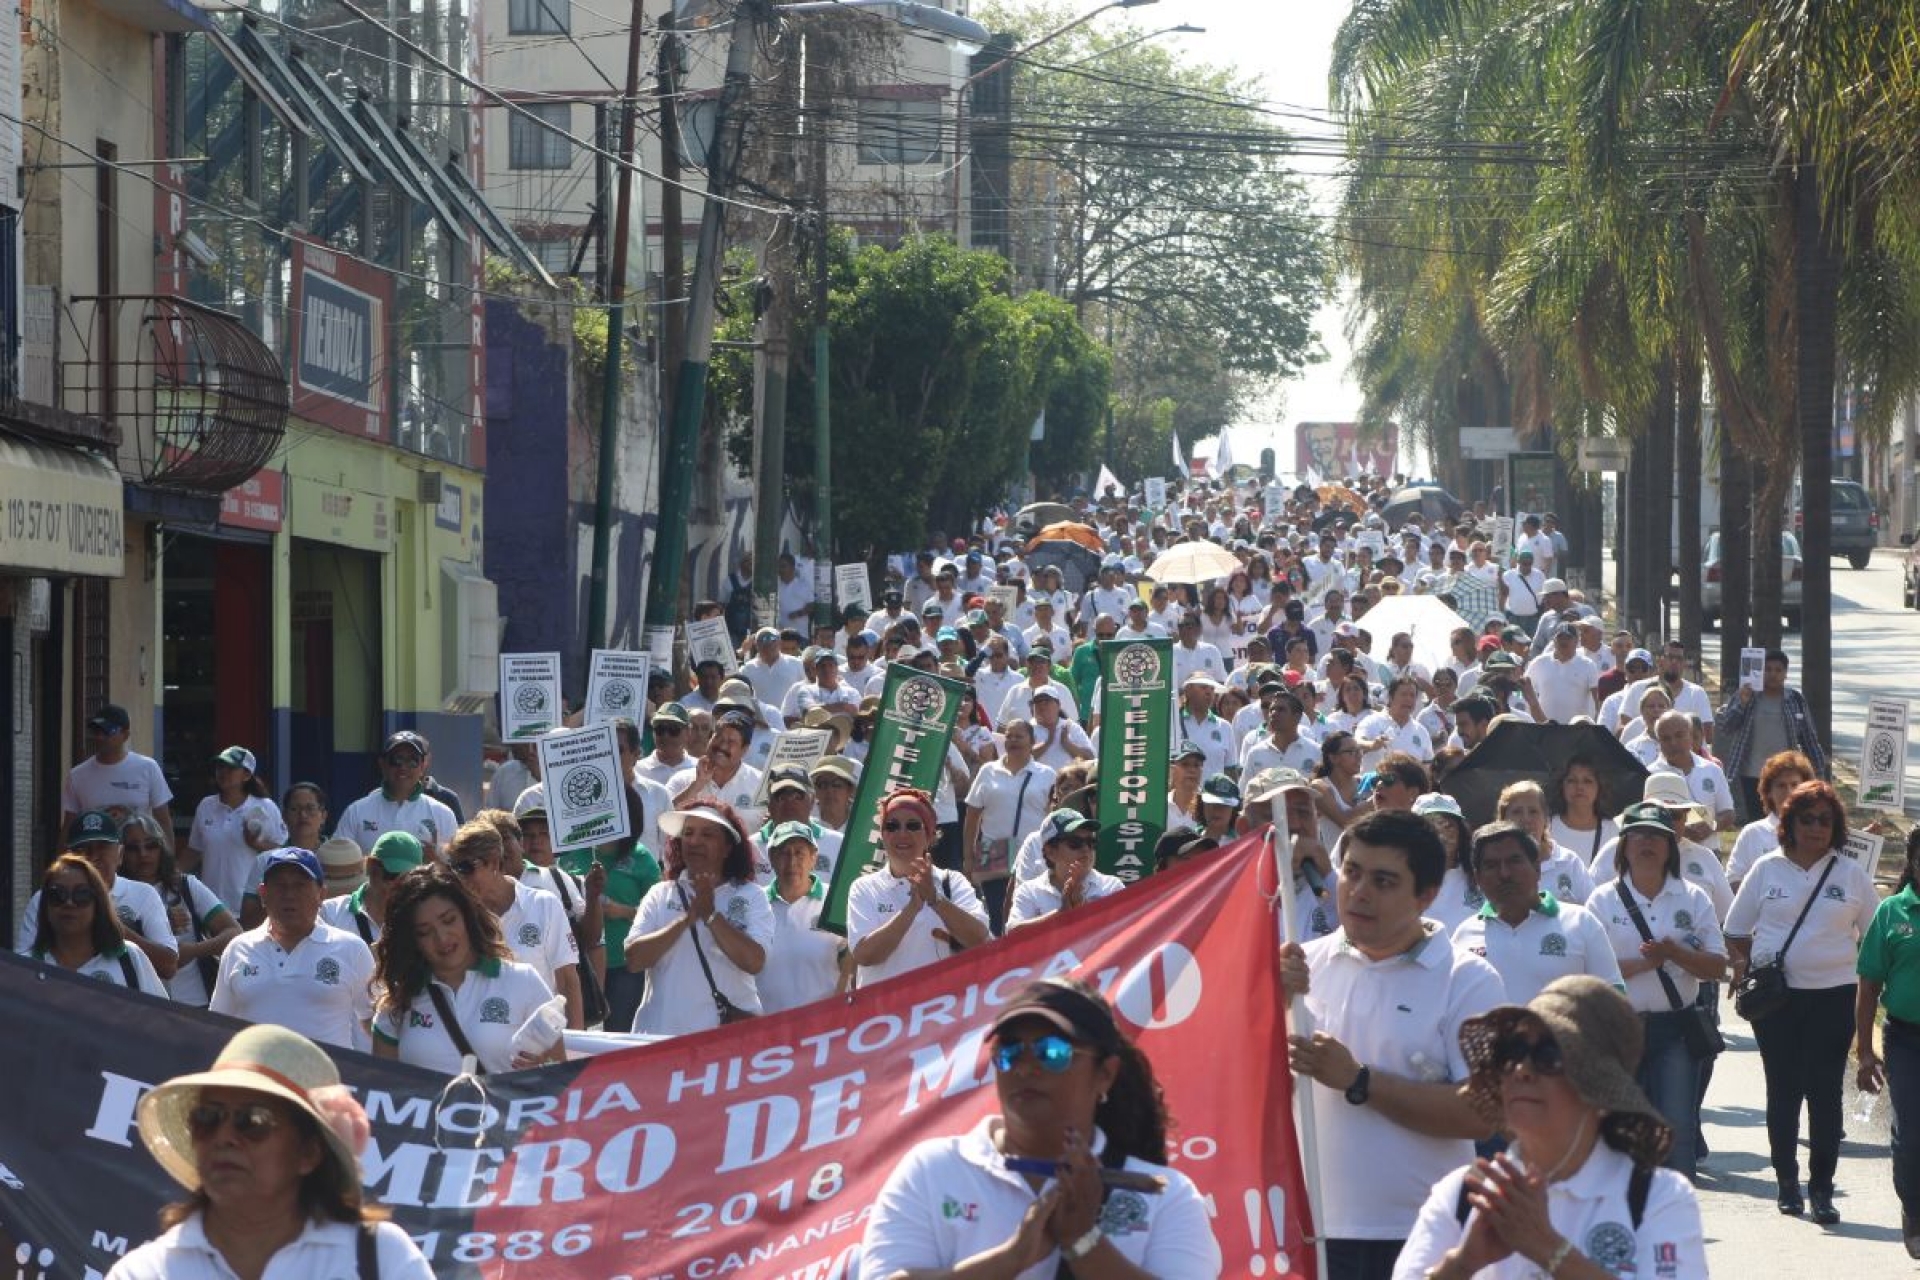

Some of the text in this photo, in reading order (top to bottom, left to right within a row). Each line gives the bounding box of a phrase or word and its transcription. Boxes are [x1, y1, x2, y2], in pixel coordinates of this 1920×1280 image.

[8, 498, 25, 540] 119
[28, 500, 43, 541] 57
[46, 503, 61, 543] 07
[1113, 693, 1150, 883] TELEFONISTAS
[668, 949, 1084, 1103] HISTORICA
[715, 1066, 866, 1175] DE
[670, 1162, 845, 1240] 2018
[687, 1203, 876, 1279] CANANEA
